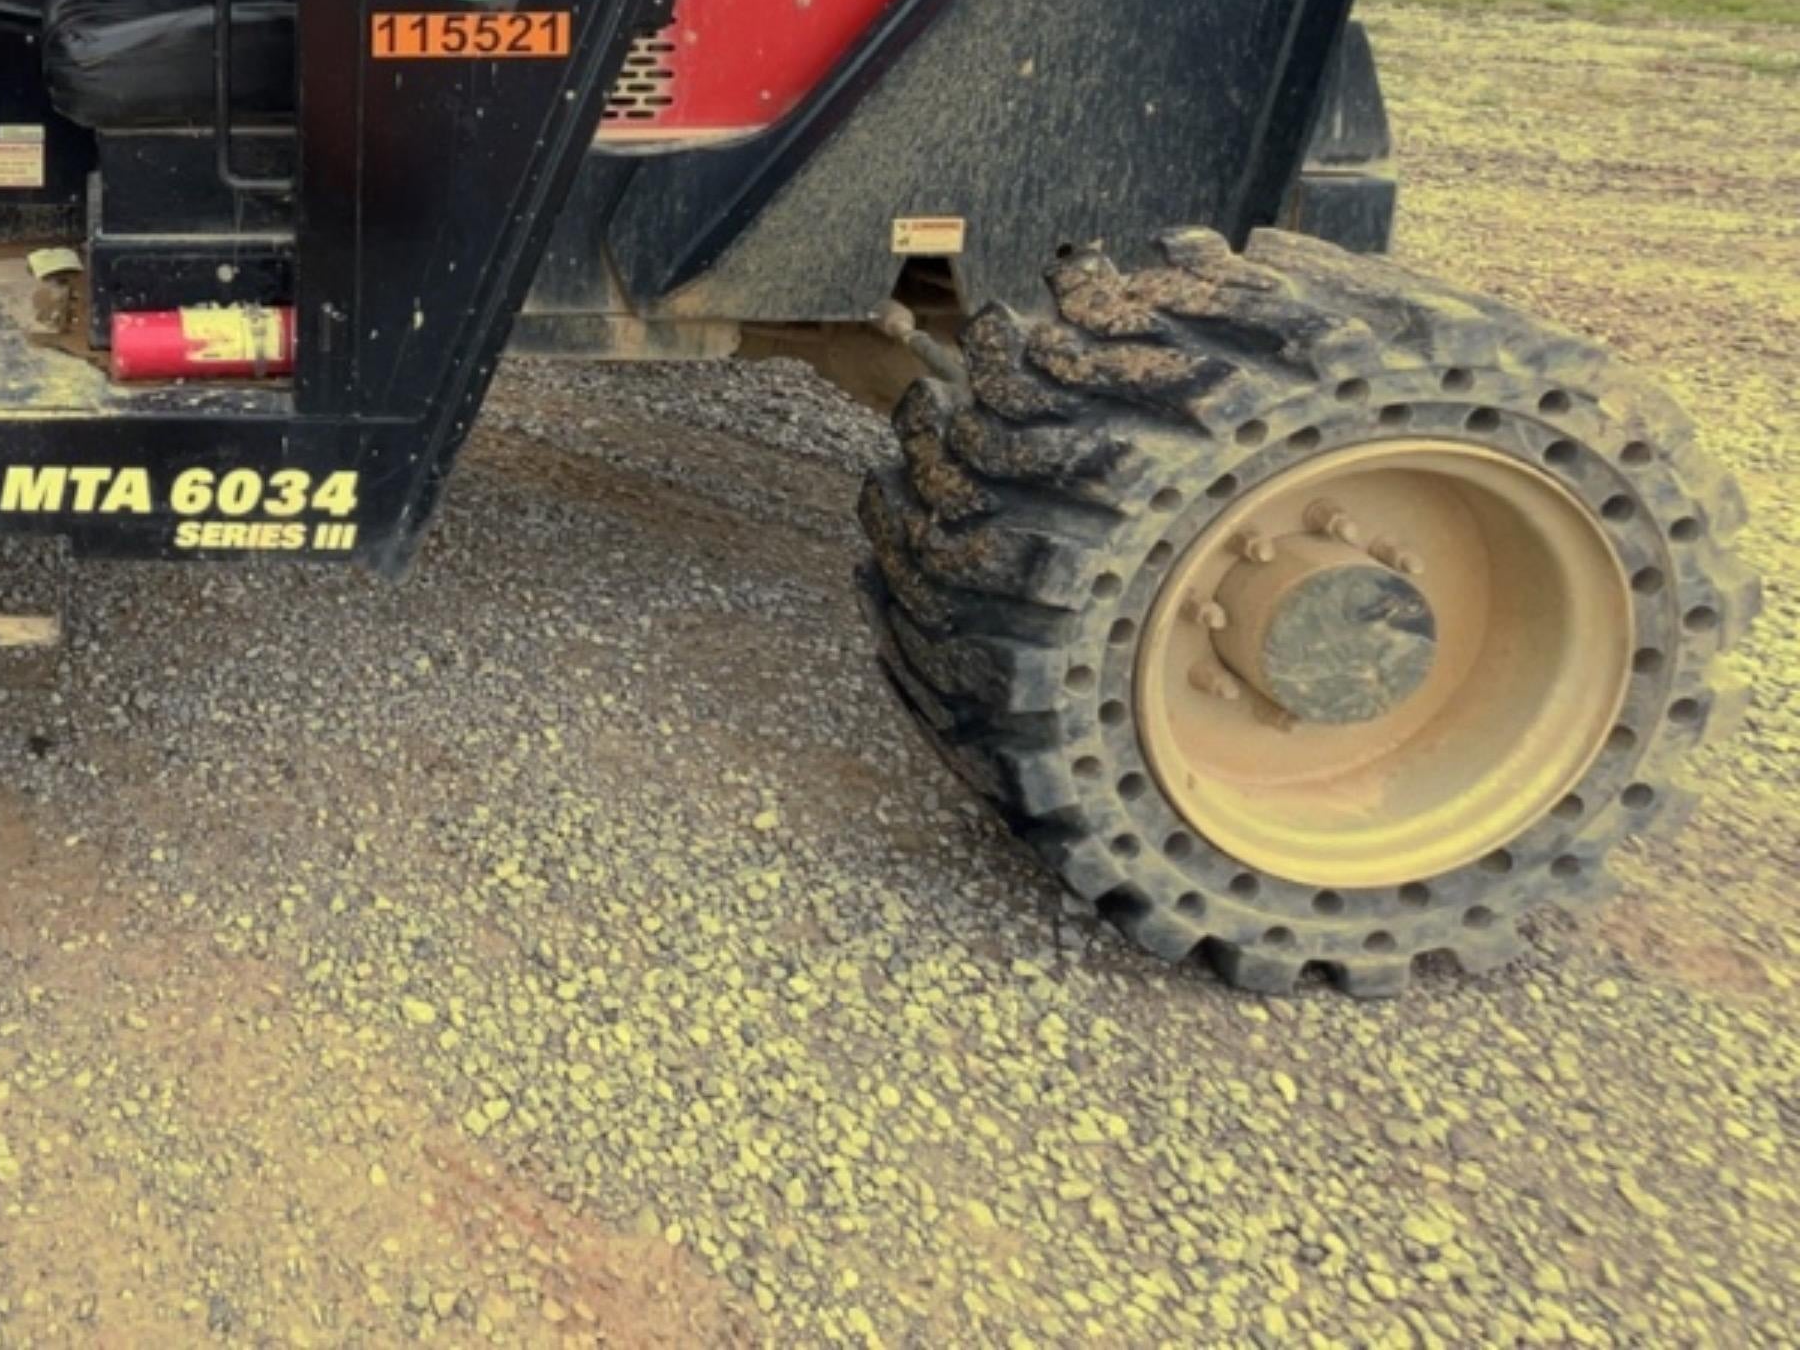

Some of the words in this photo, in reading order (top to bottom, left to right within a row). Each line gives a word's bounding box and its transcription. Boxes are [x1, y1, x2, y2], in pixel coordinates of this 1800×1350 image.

[376, 13, 559, 53] 115521
[0, 465, 152, 514] MTA
[169, 467, 359, 517] 6034
[173, 520, 308, 550] SERIES
[312, 522, 358, 550] III
